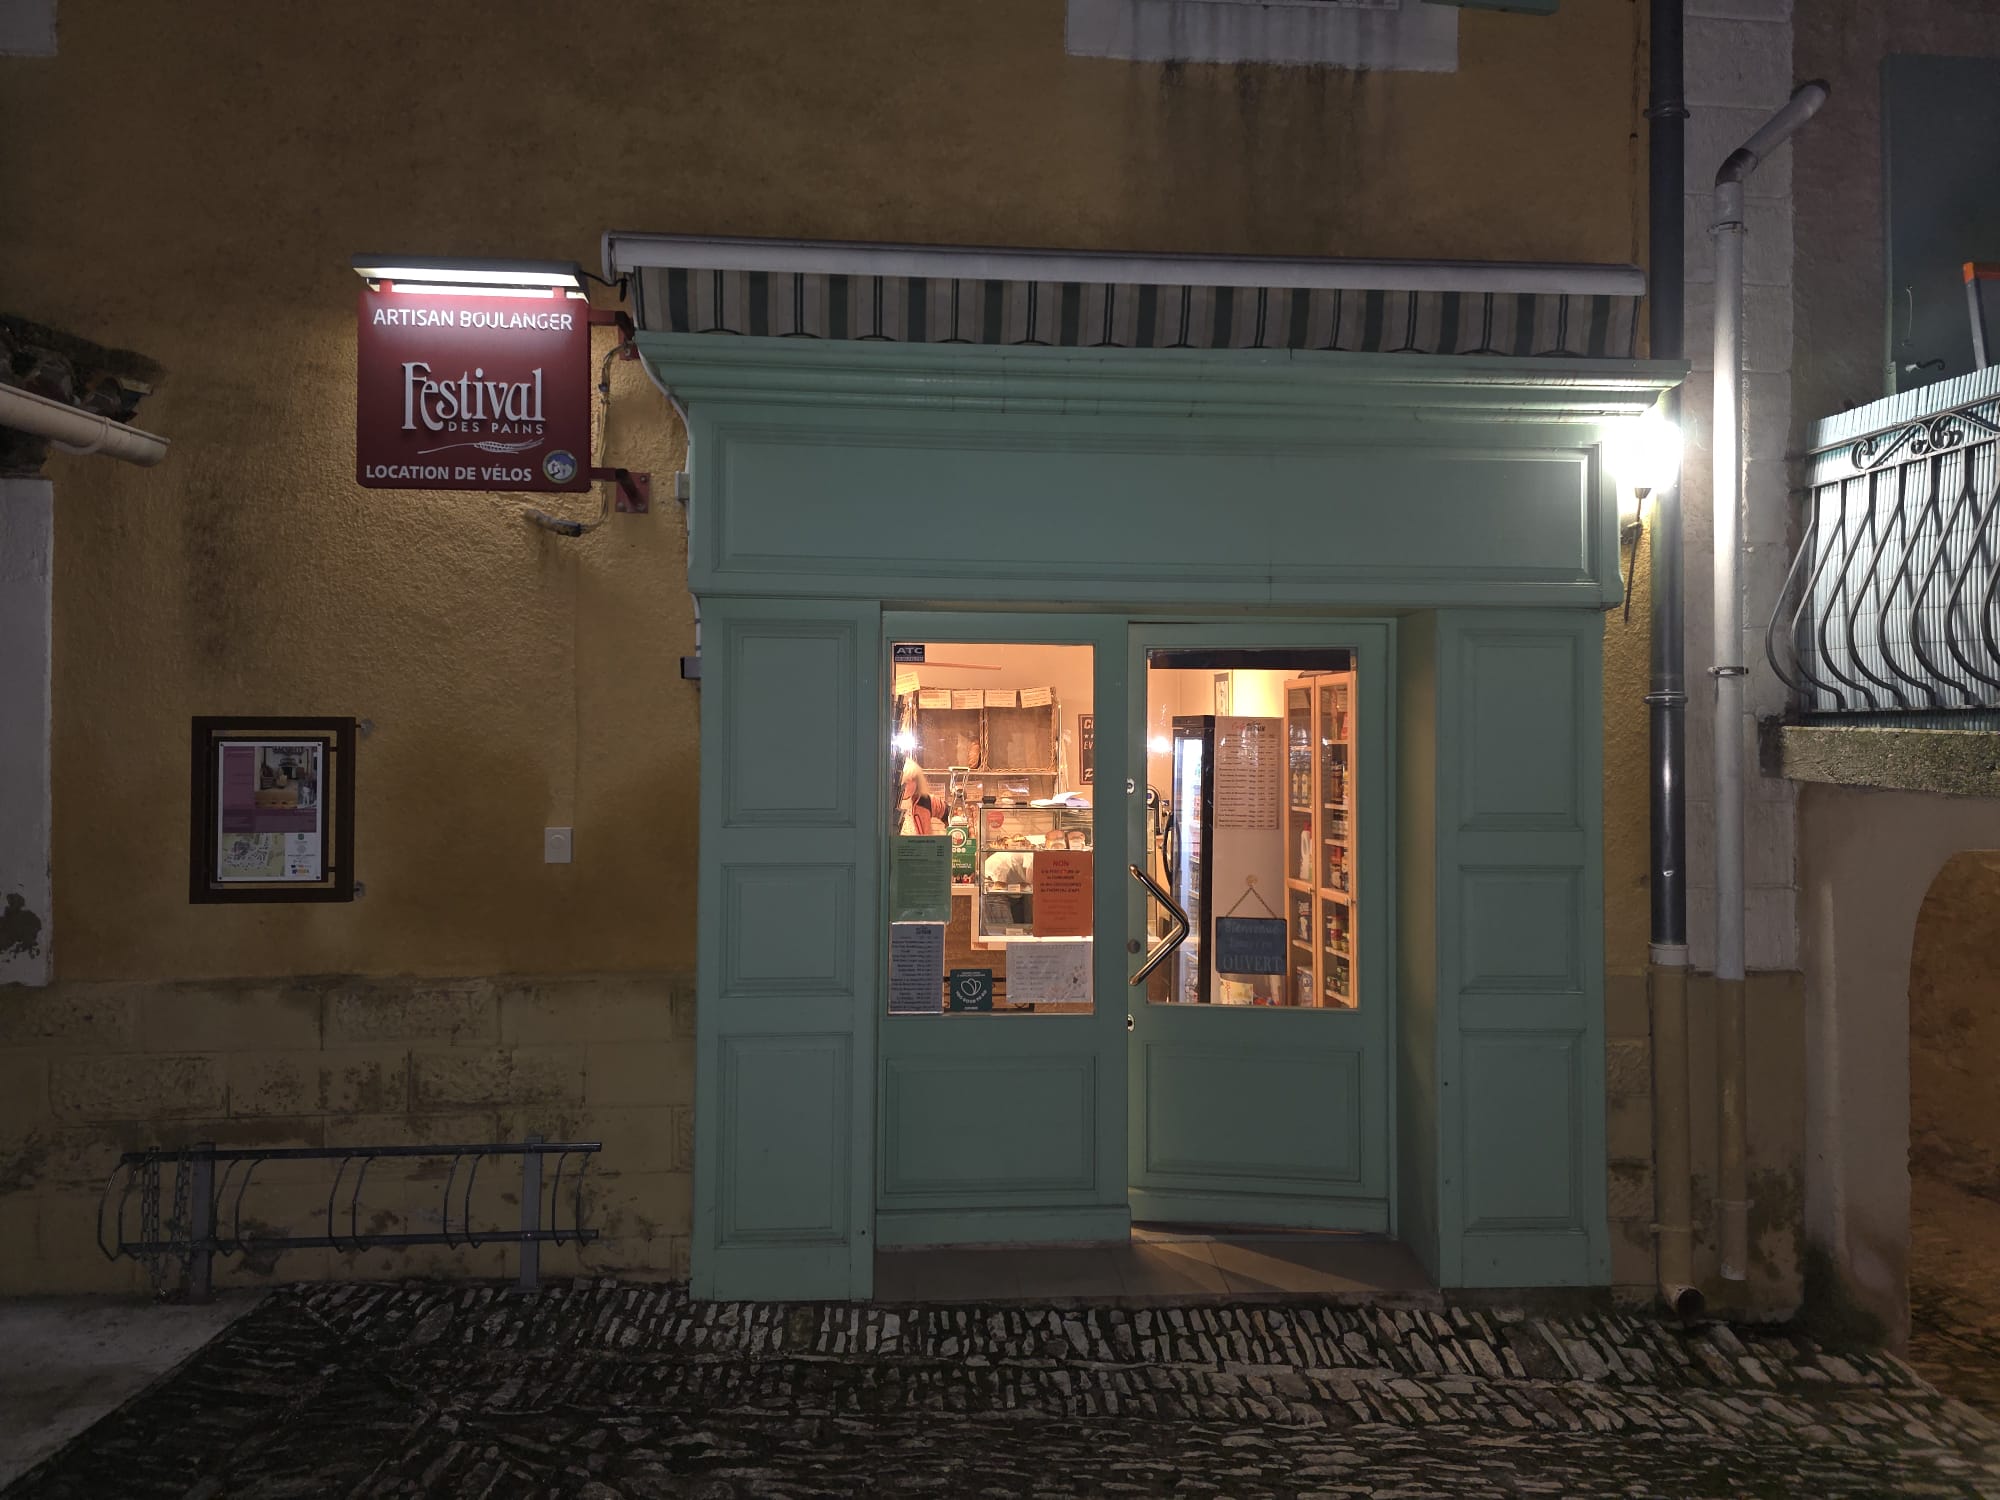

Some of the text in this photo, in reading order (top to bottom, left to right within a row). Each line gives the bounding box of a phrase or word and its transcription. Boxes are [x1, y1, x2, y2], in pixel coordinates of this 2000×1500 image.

[373, 308, 573, 331] ARTISAN BOULANGER
[401, 361, 546, 432] Festival
[448, 421, 544, 435] DES PAINS
[366, 463, 533, 482] LOCATION DE VÉLOS
[1223, 954, 1282, 972] OUVERT
